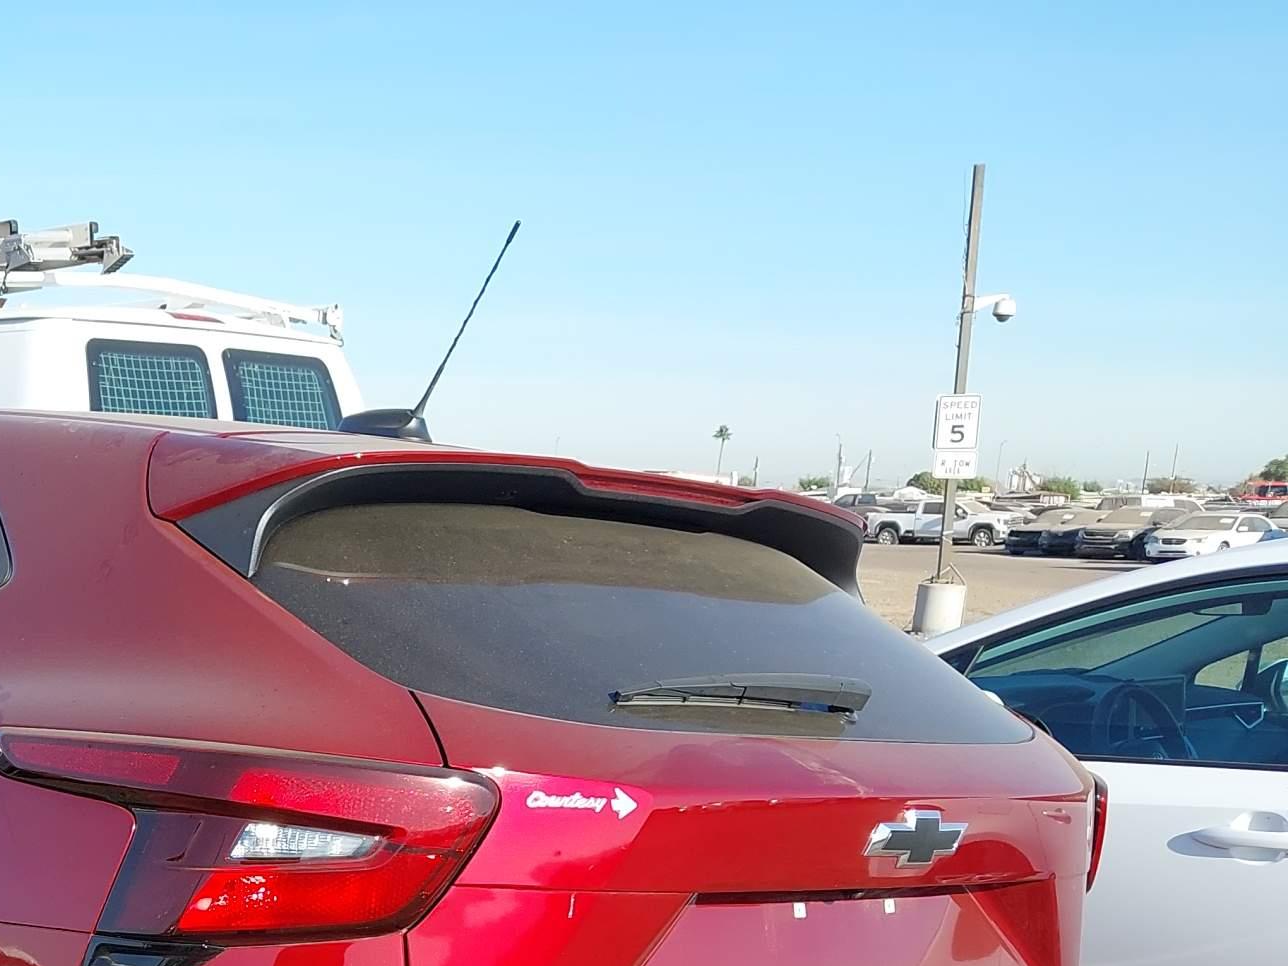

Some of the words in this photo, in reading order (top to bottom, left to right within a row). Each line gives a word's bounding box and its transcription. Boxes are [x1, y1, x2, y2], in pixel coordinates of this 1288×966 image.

[942, 400, 978, 409] SPEED
[945, 411, 972, 421] LIMIT
[950, 424, 965, 443] 5
[526, 790, 608, 813] Courtesy
